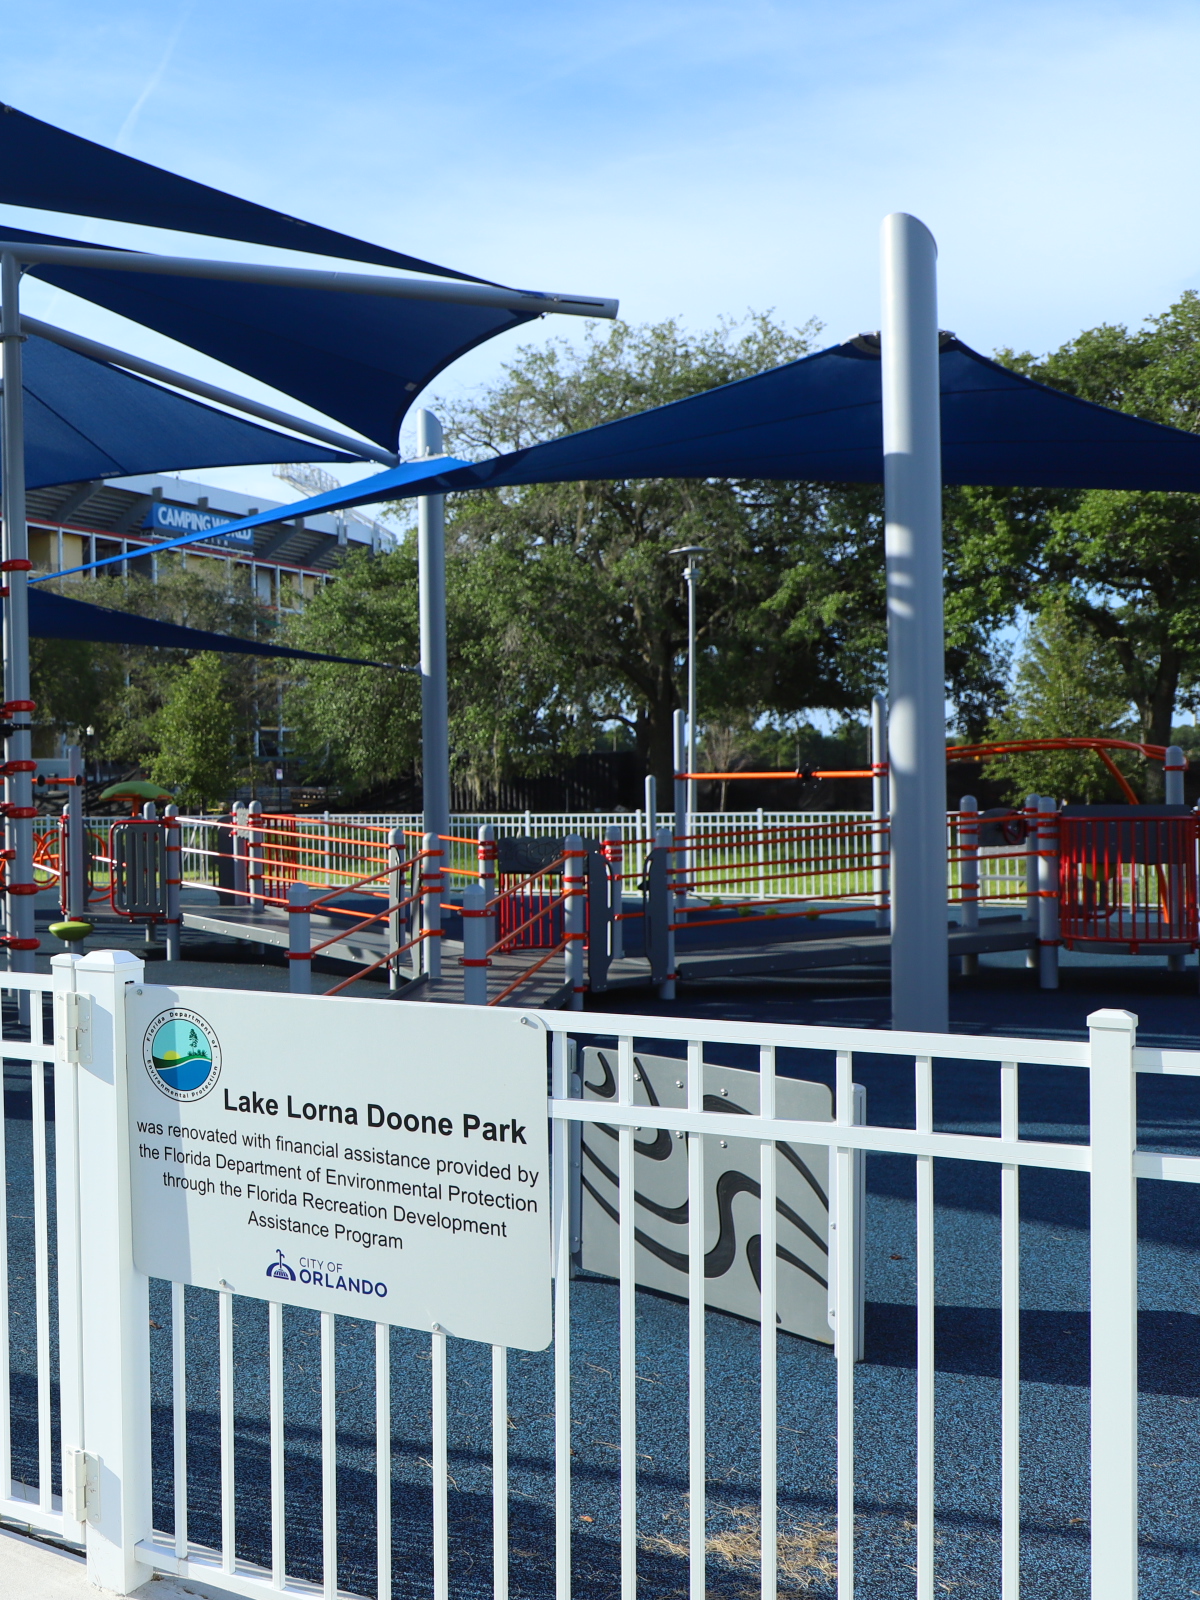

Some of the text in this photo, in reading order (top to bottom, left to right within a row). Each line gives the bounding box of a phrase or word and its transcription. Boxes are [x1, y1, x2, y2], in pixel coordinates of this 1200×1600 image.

[158, 506, 211, 531] CAMPING
[147, 1012, 218, 1048] Florida Department of
[147, 1059, 218, 1098] Environmental Protection
[224, 1088, 527, 1145] Lake Lorna Doone Park
[136, 1120, 539, 1188] was renovated with financial assistance provided by
[139, 1143, 537, 1213] the Florida Department of Environmental Protection
[163, 1172, 507, 1238] through the Florida Recreation Development
[248, 1210, 403, 1249] Assistance Program
[299, 1257, 343, 1273] CITY OF
[299, 1268, 388, 1298] ORLANDO
